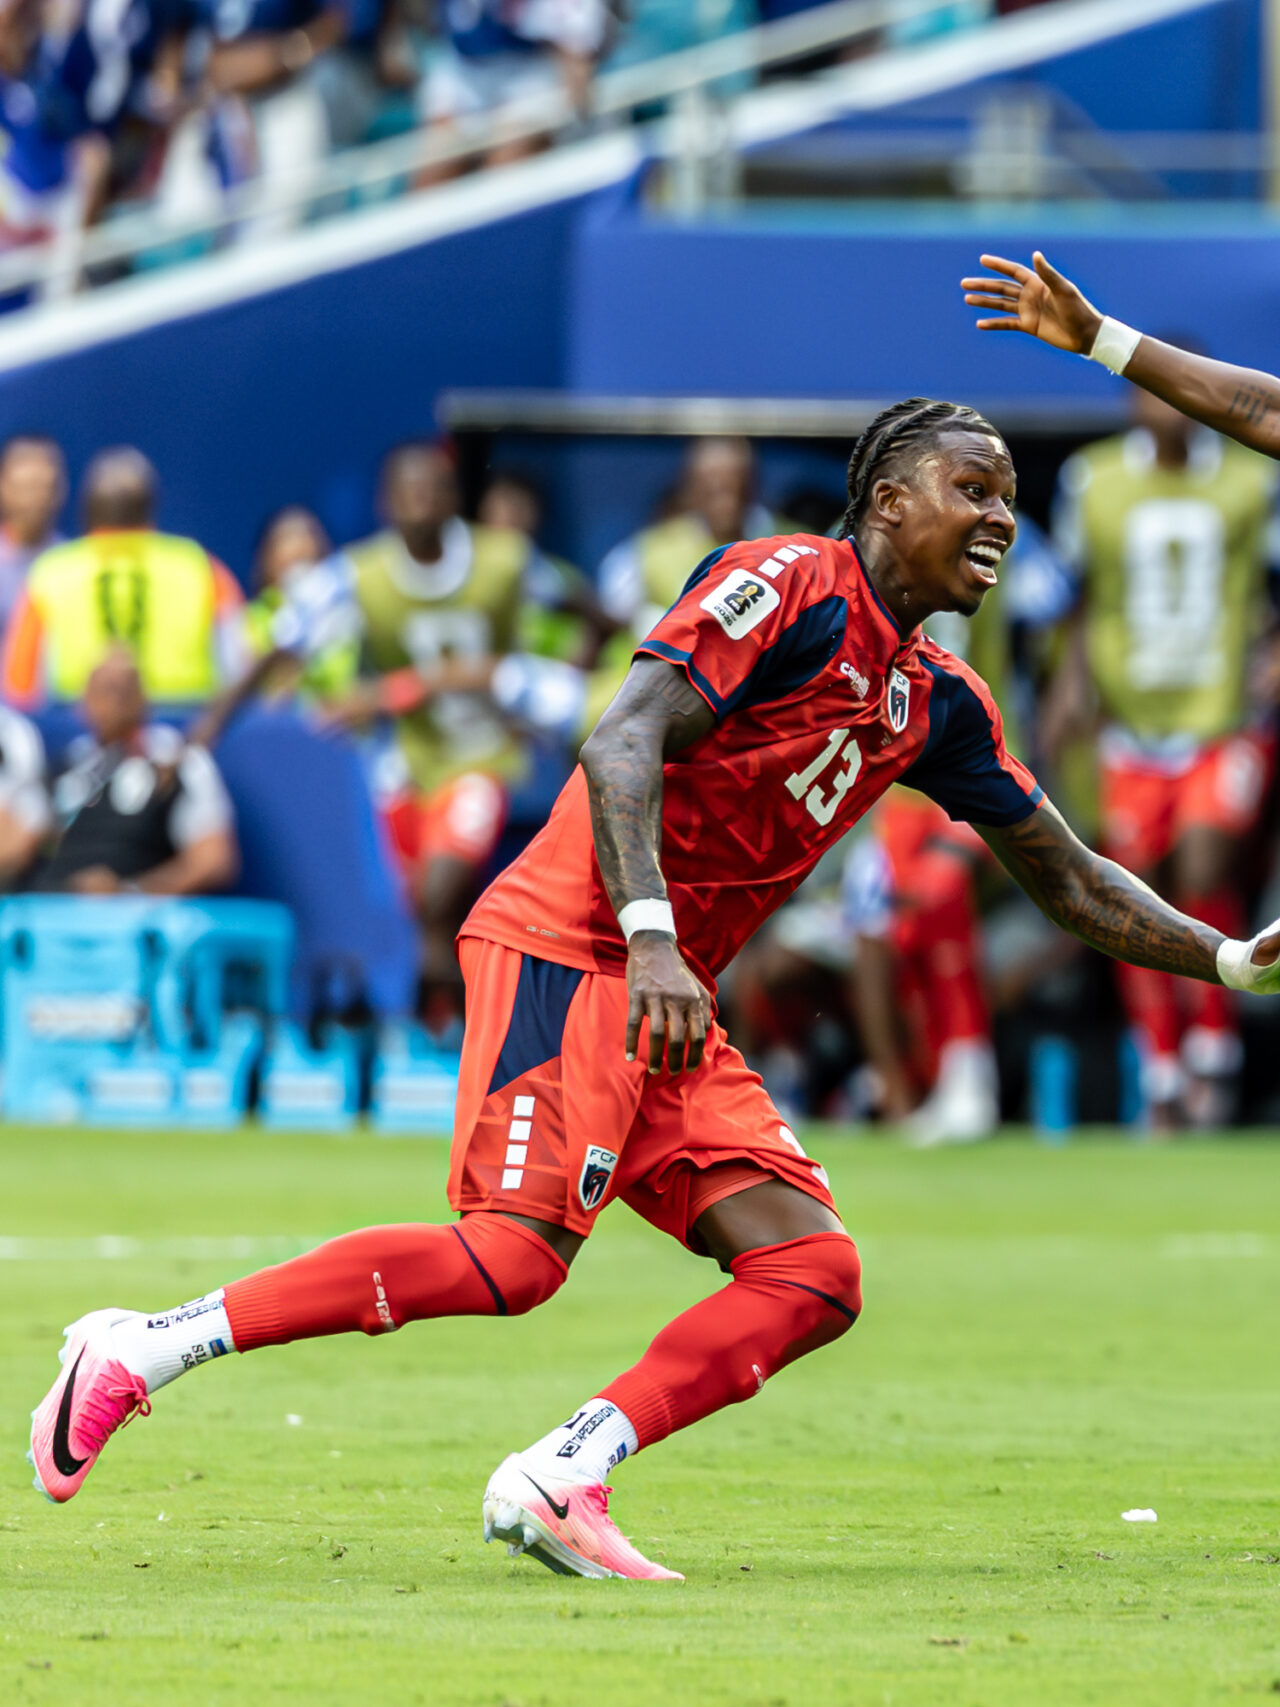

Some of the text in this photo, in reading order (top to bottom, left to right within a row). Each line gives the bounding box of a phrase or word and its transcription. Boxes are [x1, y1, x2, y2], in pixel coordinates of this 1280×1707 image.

[784, 728, 862, 826] 13
[590, 1149, 616, 1164] FCF
[572, 1404, 617, 1443] TAPEDESIGN
